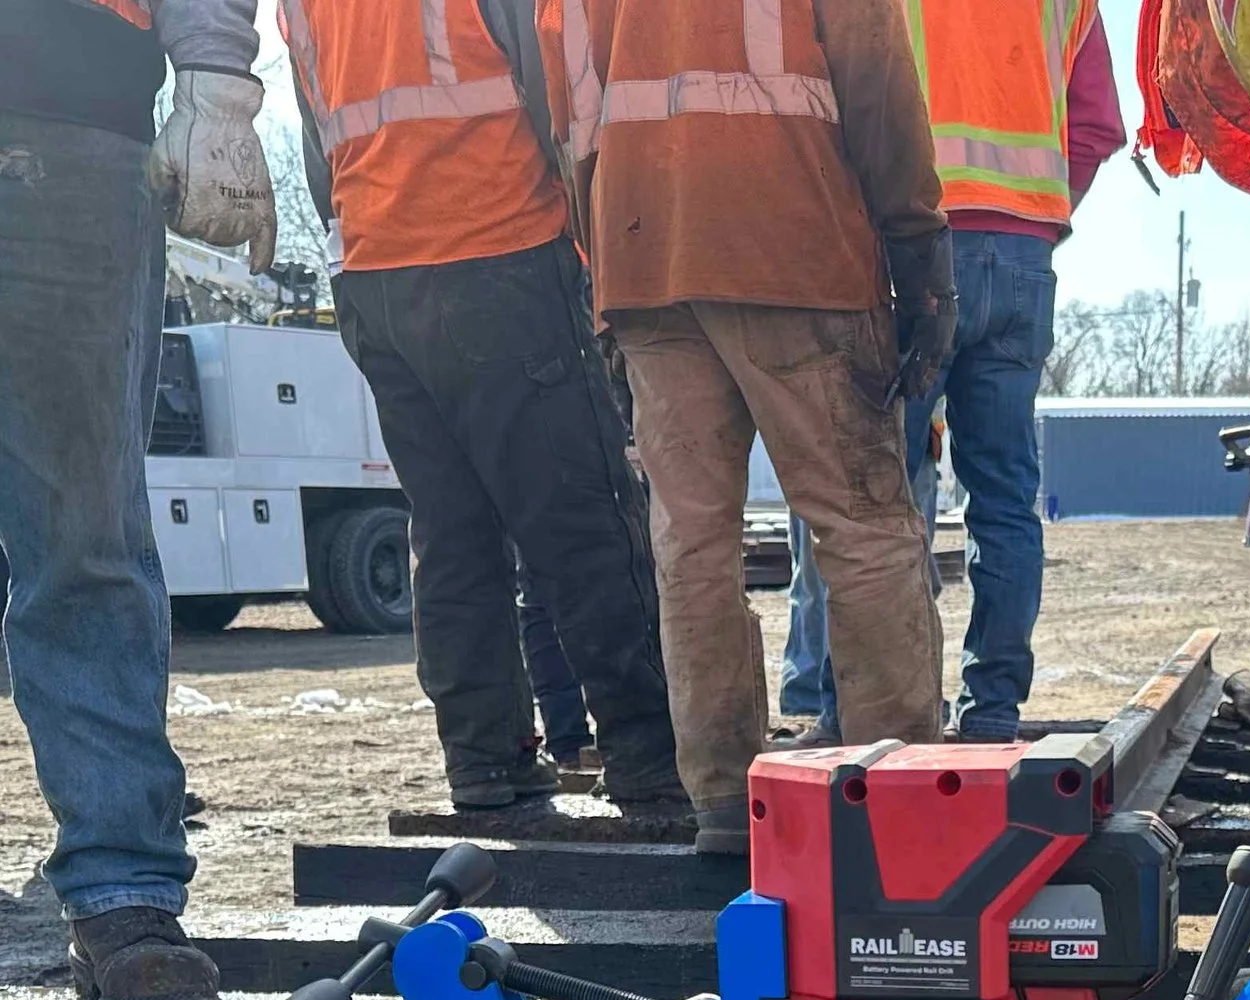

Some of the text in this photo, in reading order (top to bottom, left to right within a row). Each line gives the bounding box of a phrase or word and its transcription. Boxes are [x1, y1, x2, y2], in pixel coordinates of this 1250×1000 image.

[219, 186, 267, 200] TILLMAN
[1054, 918, 1097, 930] HIGH
[850, 937, 966, 957] RAIL EASE
[1054, 943, 1095, 956] M18
[862, 965, 889, 974] Battery
[890, 965, 922, 974] Powered
[923, 966, 937, 974] Rail
